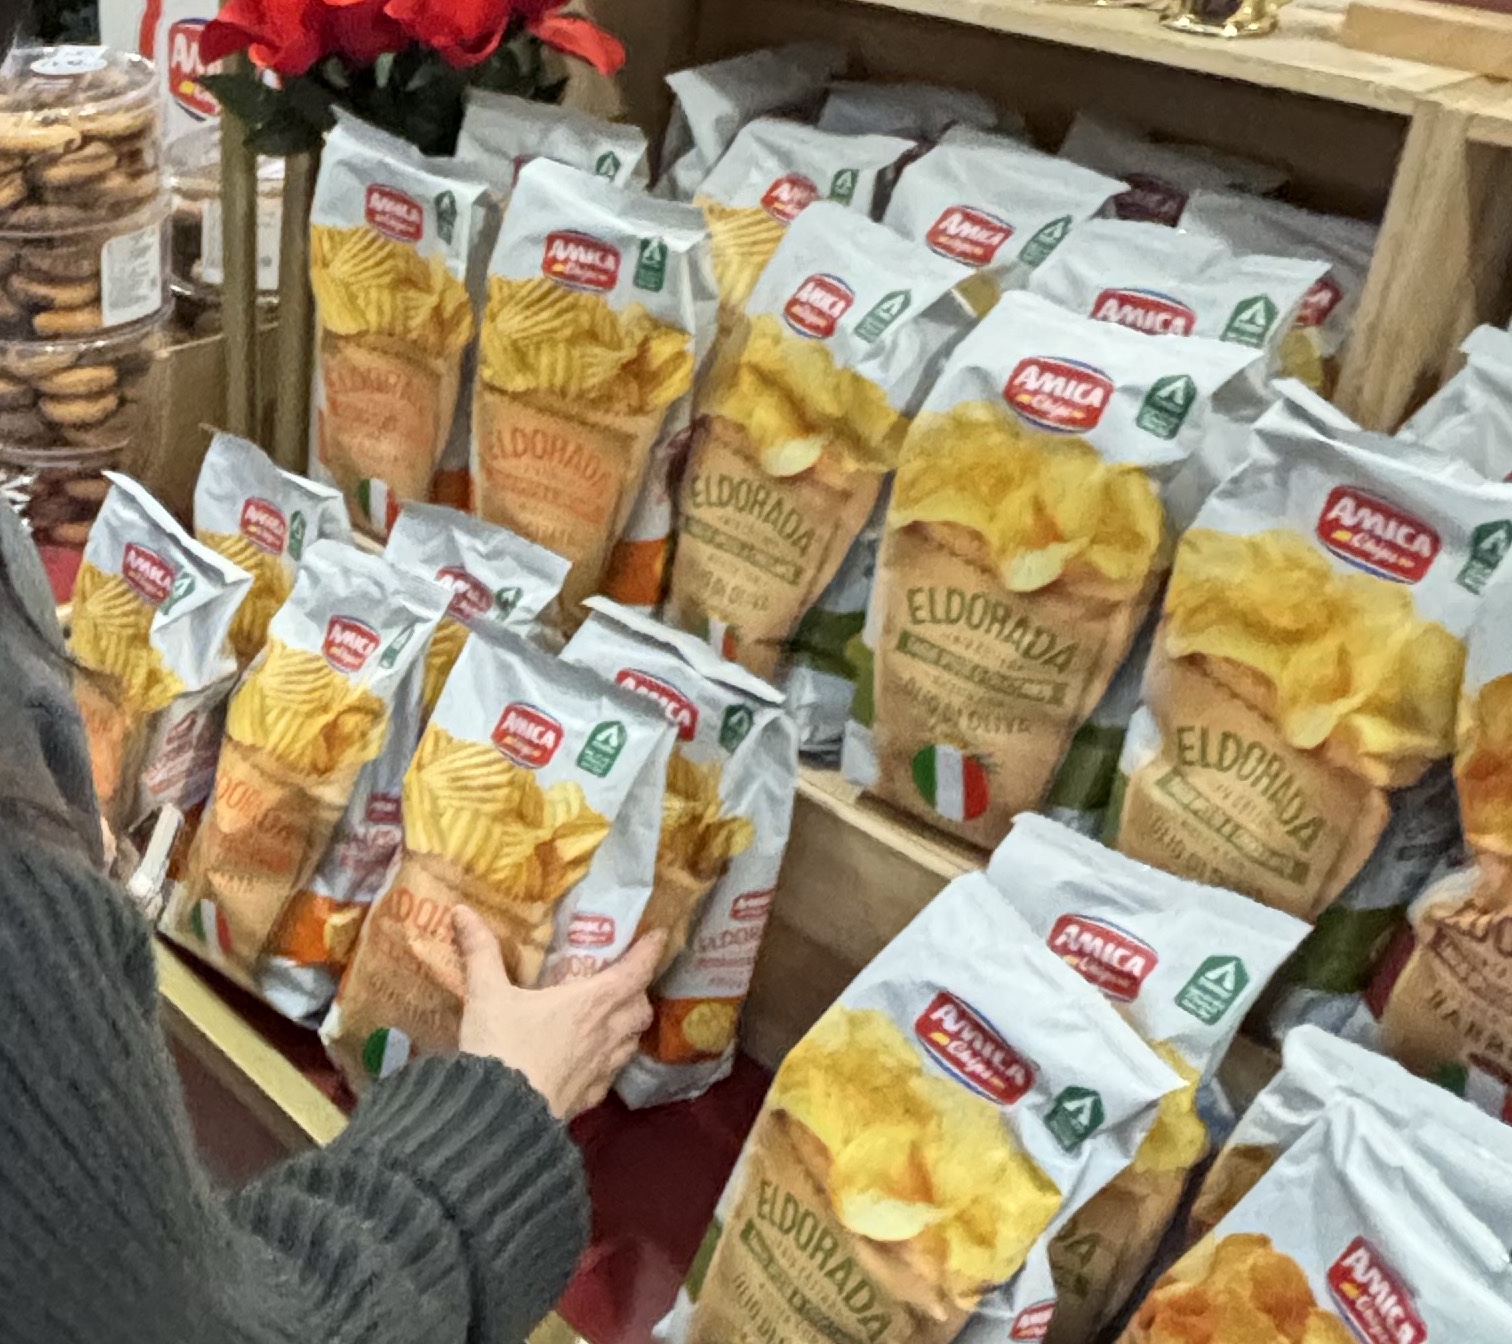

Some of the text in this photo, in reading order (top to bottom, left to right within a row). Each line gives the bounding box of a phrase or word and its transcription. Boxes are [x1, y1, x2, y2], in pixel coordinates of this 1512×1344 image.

[1097, 298, 1188, 337] AMICA
[1013, 364, 1105, 409] AMICA
[690, 472, 817, 558] ELDORADA
[1326, 495, 1433, 559] AMICA
[906, 586, 1079, 674] ELDORADA
[1176, 725, 1326, 852] ELDORADA
[1053, 923, 1150, 978] AMICA
[929, 1003, 1028, 1088] AMICA
[756, 1178, 892, 1344] ELDORADA
